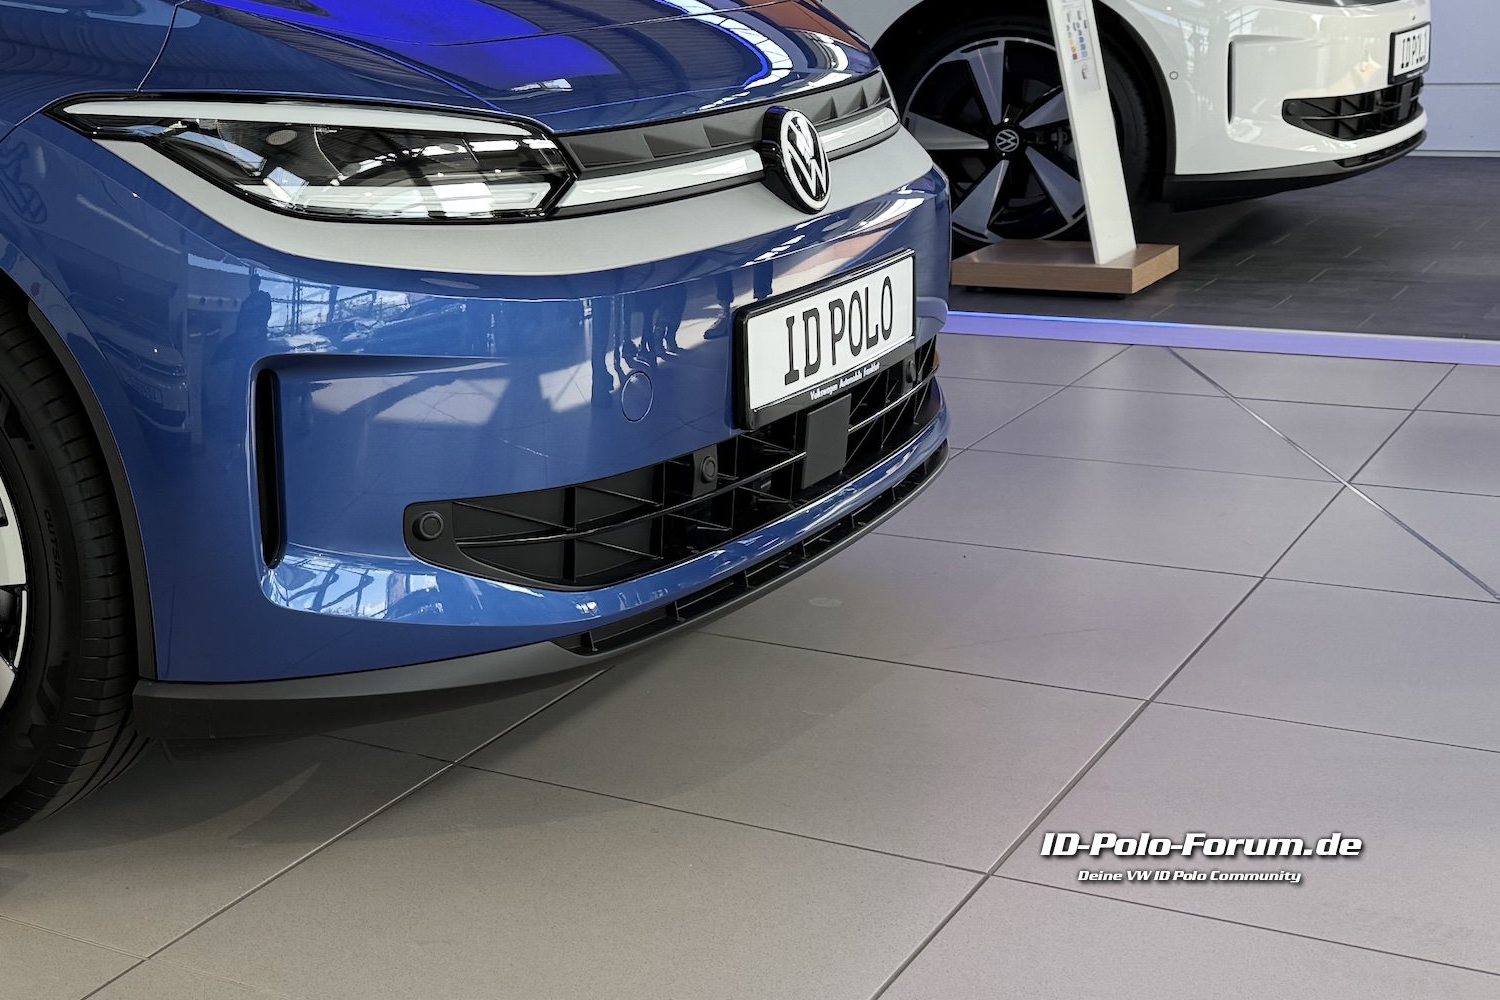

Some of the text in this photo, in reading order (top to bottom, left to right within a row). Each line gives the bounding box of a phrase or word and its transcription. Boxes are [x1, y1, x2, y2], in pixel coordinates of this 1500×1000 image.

[784, 275, 894, 386] ID POLO
[43, 508, 65, 594] OUTSIDE
